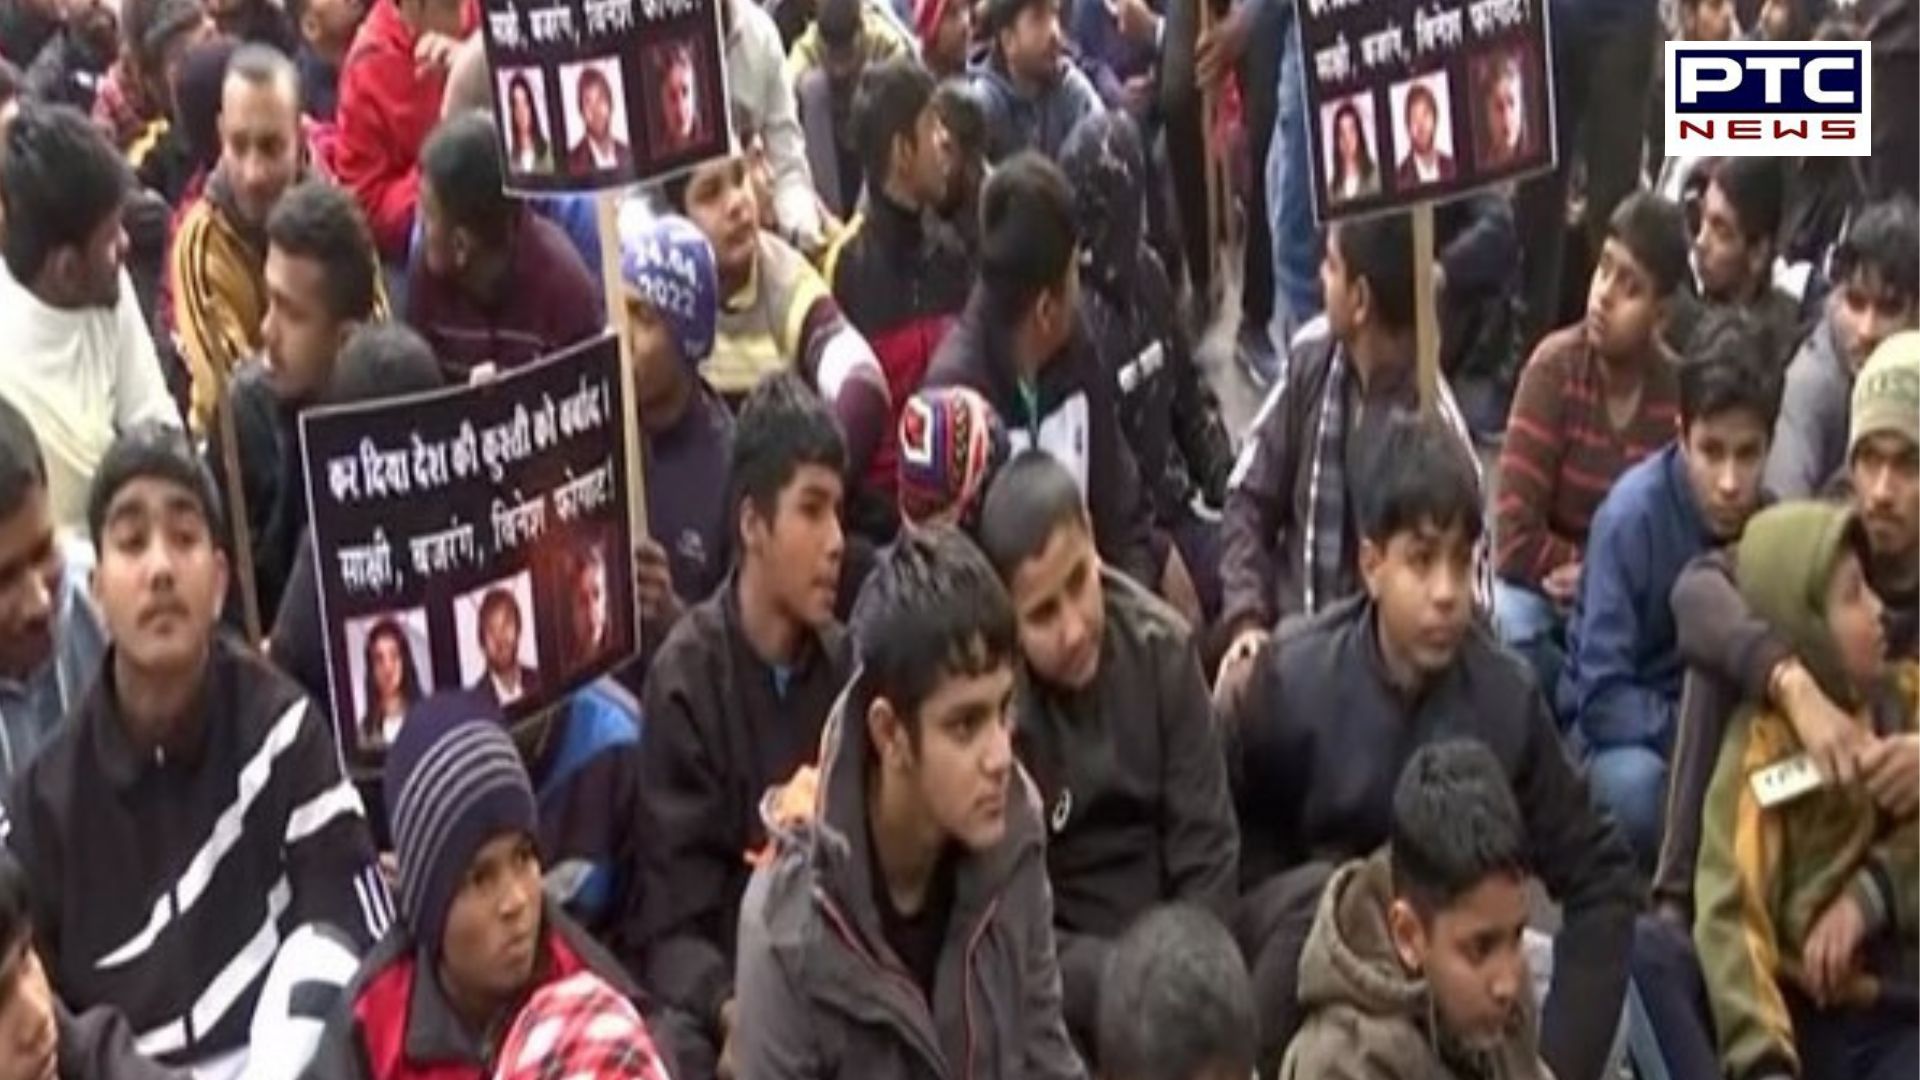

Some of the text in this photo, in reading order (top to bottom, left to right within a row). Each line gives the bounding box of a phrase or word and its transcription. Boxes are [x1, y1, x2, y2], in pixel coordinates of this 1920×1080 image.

[327, 453, 361, 502] कर
[359, 435, 410, 498] दिया
[410, 430, 449, 490] देश
[451, 419, 481, 478] की
[532, 391, 559, 450] को
